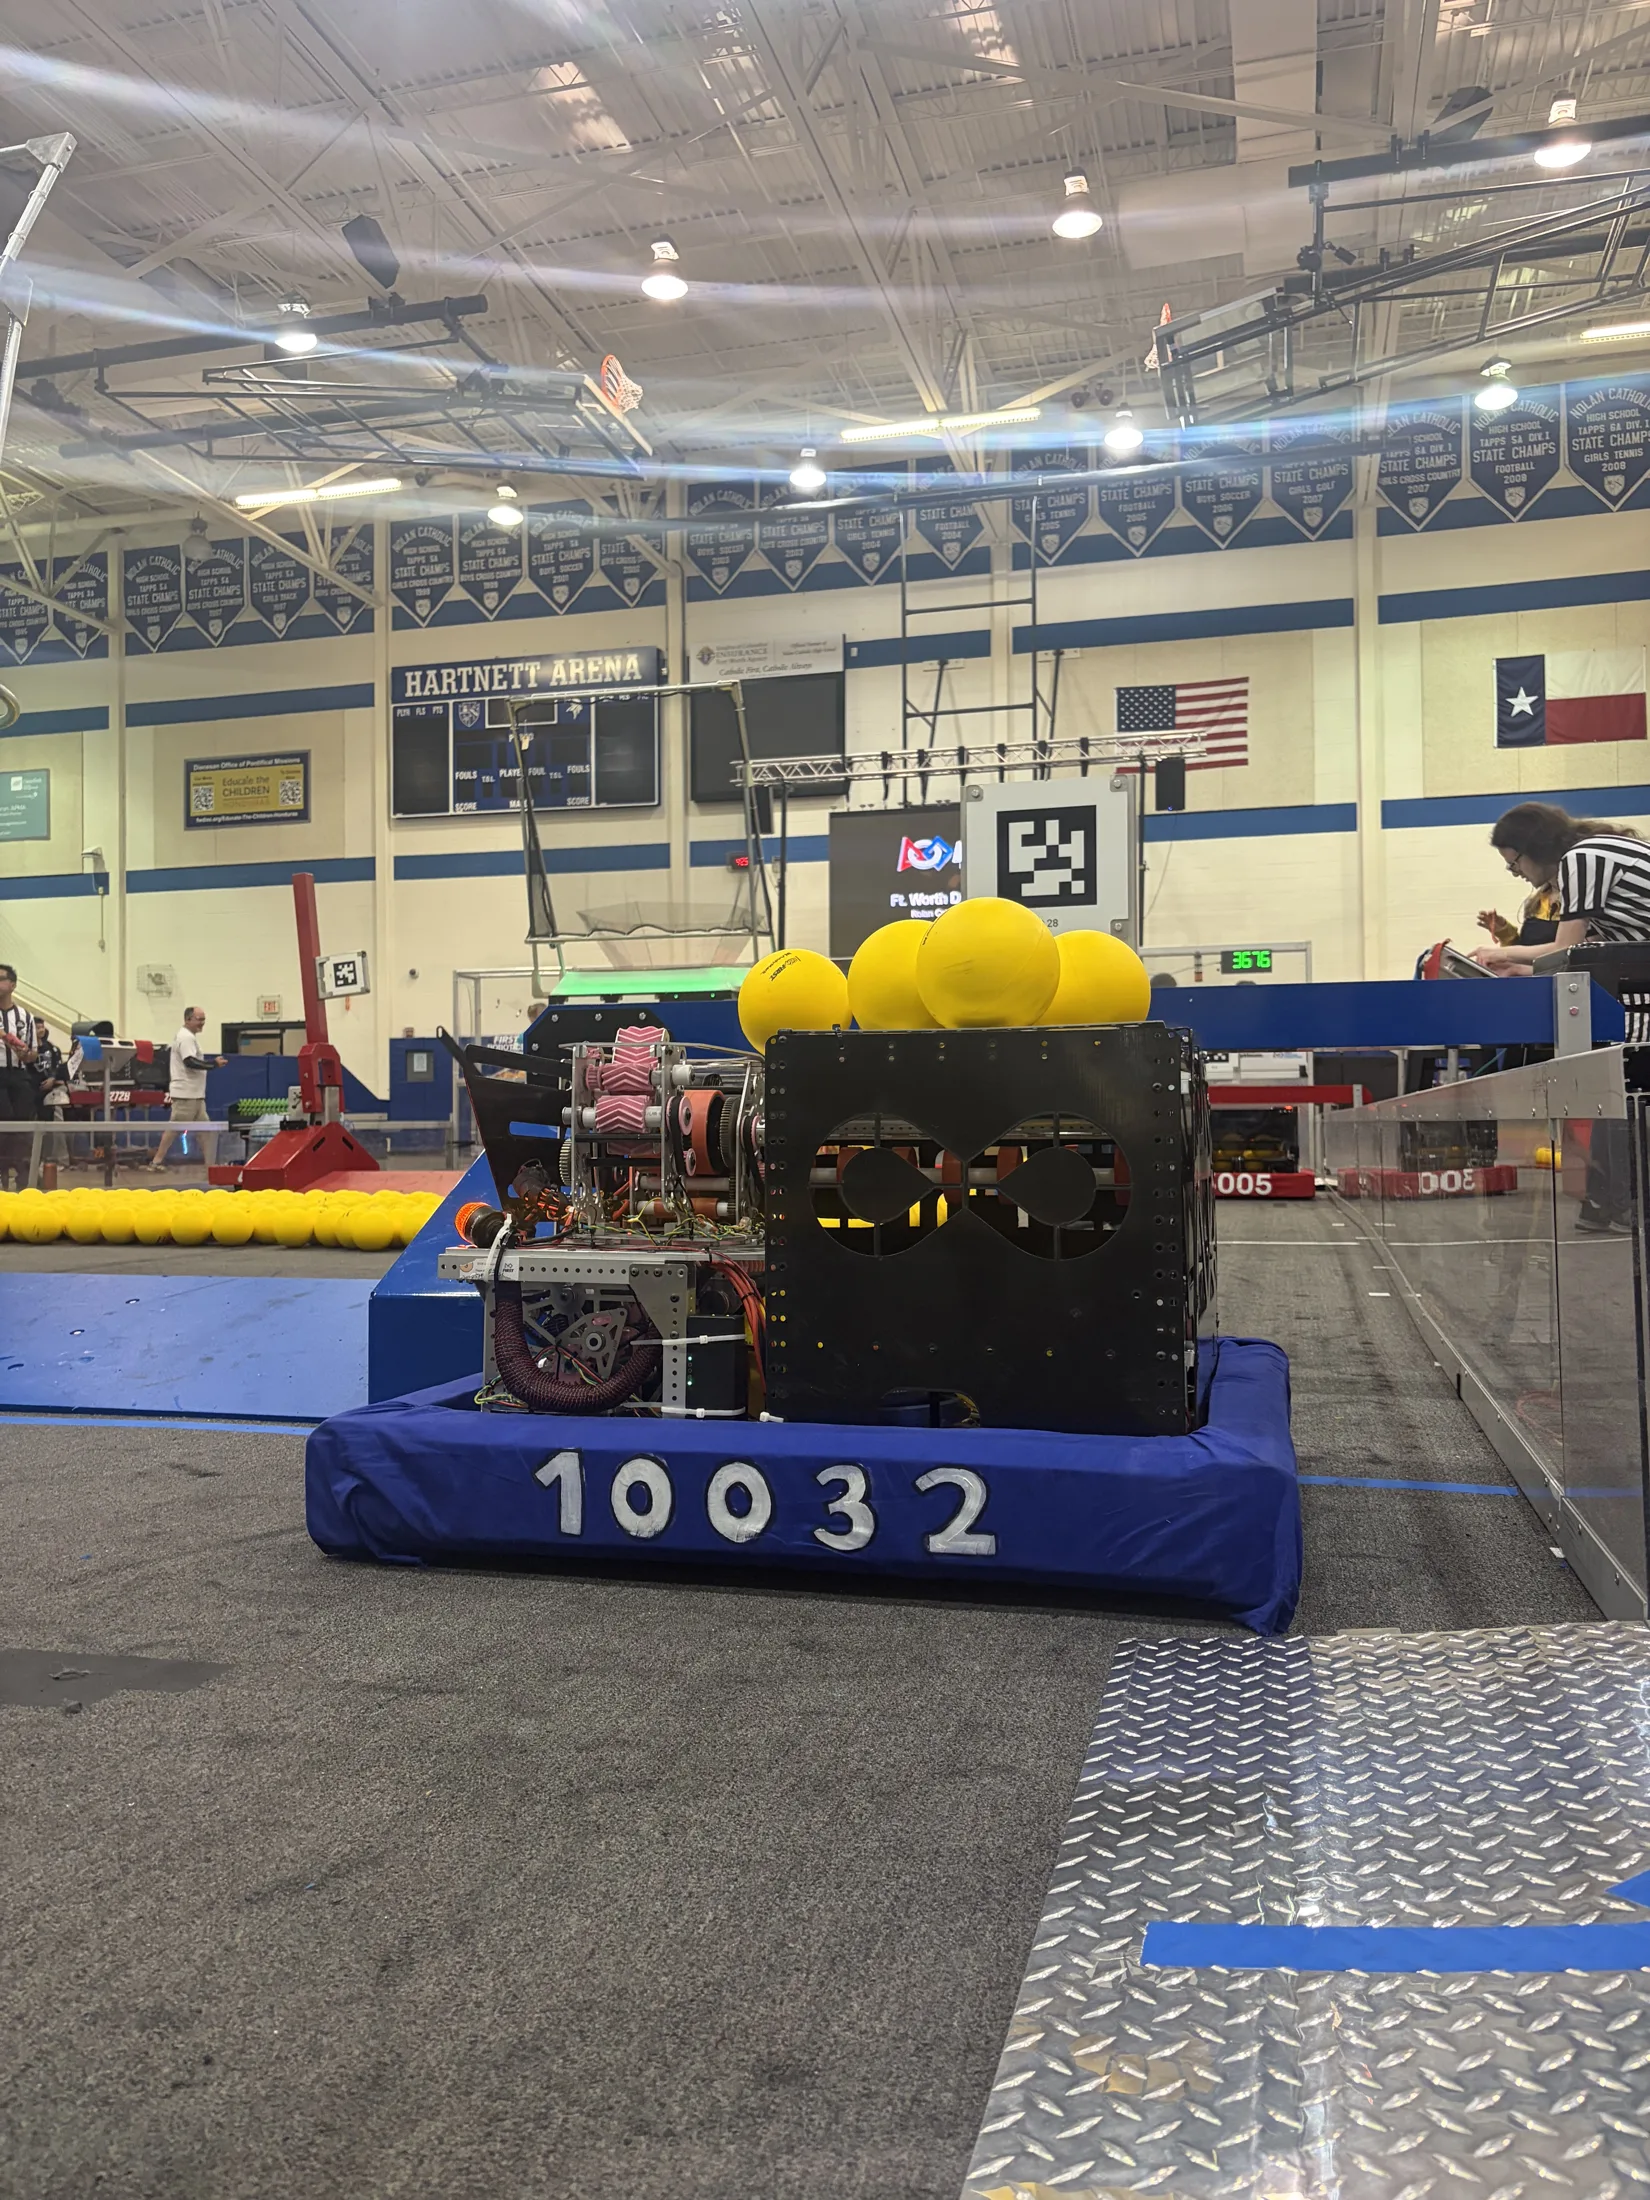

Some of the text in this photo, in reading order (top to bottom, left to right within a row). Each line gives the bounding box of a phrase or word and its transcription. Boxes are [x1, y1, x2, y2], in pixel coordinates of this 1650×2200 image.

[1511, 400, 1559, 423] CATHOLIC
[1569, 390, 1606, 419] NOLAN
[1413, 411, 1461, 434] CATHOLIC
[1586, 408, 1641, 422] HIGH SCHOOL
[1488, 421, 1542, 434] HIGH SCHOOL
[1578, 425, 1605, 435] TAPPS
[1610, 423, 1621, 431] 6A
[1626, 420, 1642, 430] DIV.
[1272, 428, 1302, 451] NOLAN
[1413, 433, 1443, 443] SCHOOL
[1480, 437, 1506, 447] TAPPS
[1511, 435, 1523, 444] 5A
[1572, 436, 1604, 451] STATE
[1473, 442, 1556, 463] STATE CHAMPS
[1584, 448, 1644, 463] GIRLS TENNIS
[1380, 454, 1457, 473] STATE CHAMPS
[1495, 461, 1535, 474] FOOTBALL
[1602, 461, 1626, 472] 2008
[1274, 464, 1348, 483] STATE CHAMPS
[1400, 468, 1461, 484] CROSS COUNTRY
[1185, 473, 1259, 492] STATE CHAMPS
[1288, 481, 1336, 495] GIRLS GOLF
[1101, 484, 1172, 501] STATE CHAMPS
[1196, 491, 1251, 503] BOYS SOCCER
[1047, 493, 1086, 508] CHAMPS
[1118, 502, 1156, 512] FOOTBALL
[920, 508, 946, 521] STATE
[1050, 509, 1076, 519] TENNIS
[762, 521, 825, 538] STATE CHAMPS
[837, 517, 864, 530] STATE
[935, 521, 970, 531] FOOTBALL
[418, 526, 452, 548] CATHOLIC
[690, 528, 752, 545] STATE CHAMPS
[601, 542, 625, 555] STATE
[462, 555, 519, 571] STATE CHAMPS
[531, 547, 591, 566] STATE CHAMPS
[395, 562, 450, 579] STATE CHAMPS
[252, 581, 275, 593] STATE
[278, 577, 306, 591] CHAMPS
[127, 590, 178, 606] STATE CHAMPS
[189, 585, 241, 601] STATE CHAMPS
[405, 653, 642, 698] HARTNETT ARENA
[220, 761, 238, 769] Office
[455, 771, 478, 780] FOULS
[499, 768, 523, 778] PLAYE
[528, 767, 546, 776] FOUL
[567, 764, 590, 774] FOULS
[222, 775, 254, 787] Educate
[256, 775, 270, 784] the
[222, 786, 270, 797] CHILDREN
[455, 797, 590, 812] SCORE SCORE
[890, 893, 908, 907] Ft.
[908, 892, 949, 906] Worth
[910, 909, 934, 918] Nolan
[1046, 918, 1059, 928] 28
[1232, 950, 1271, 969] 3676
[1213, 1172, 1272, 1195] 005
[534, 1450, 996, 1556] 10032
